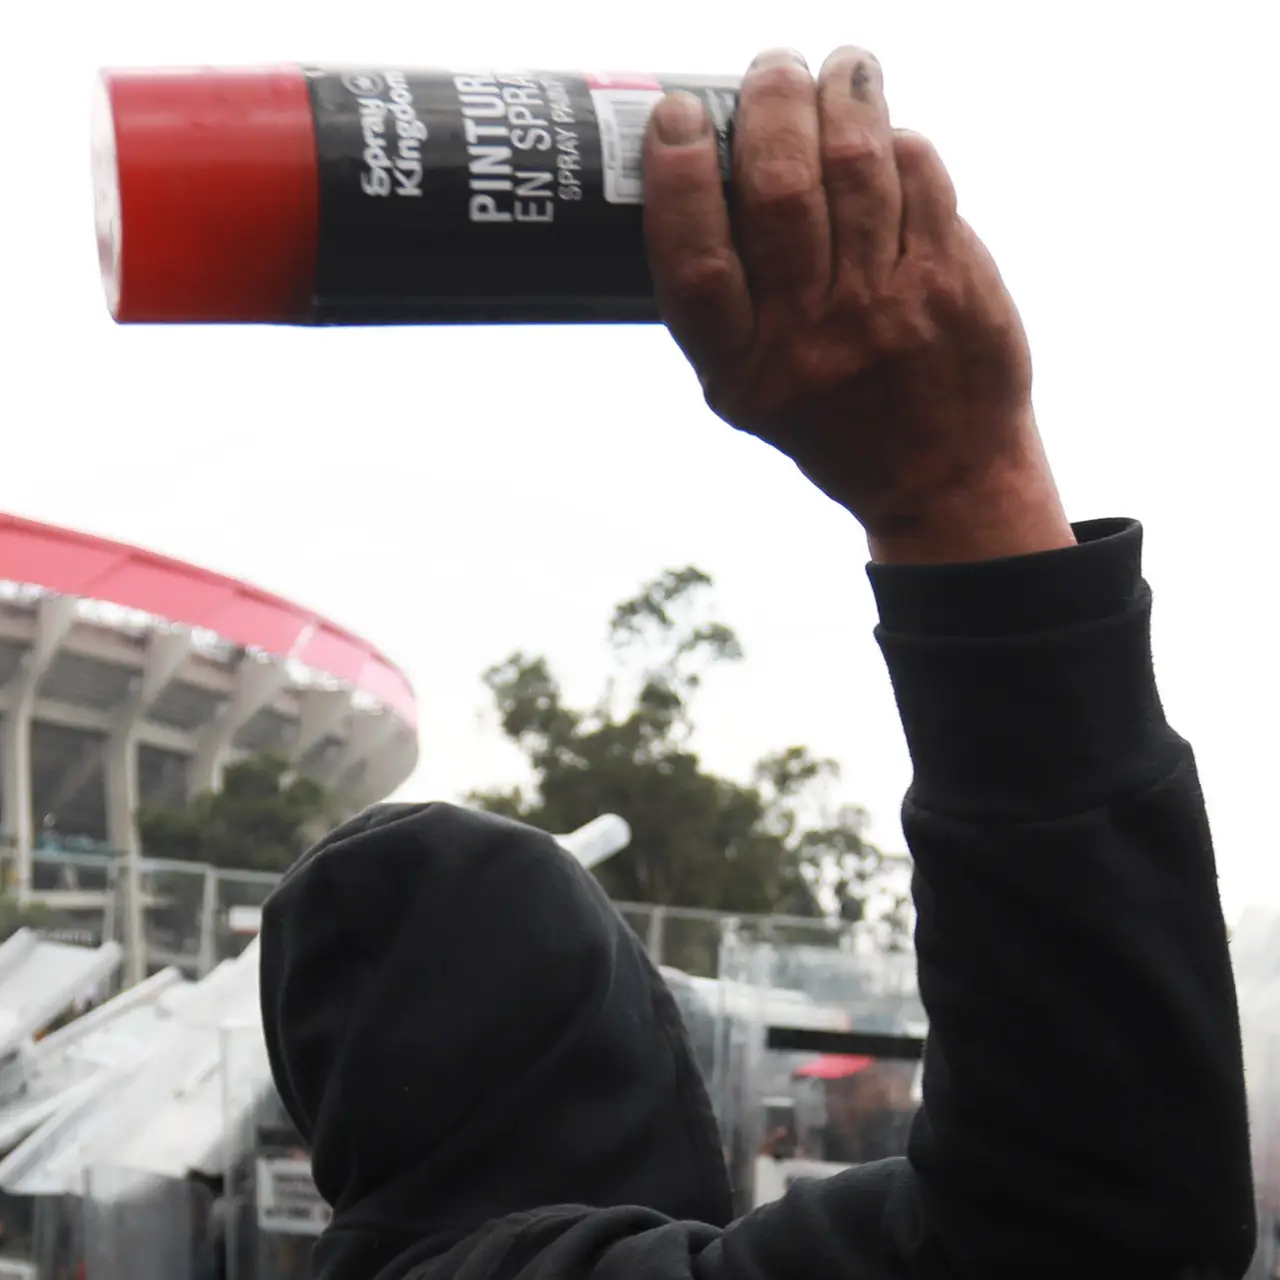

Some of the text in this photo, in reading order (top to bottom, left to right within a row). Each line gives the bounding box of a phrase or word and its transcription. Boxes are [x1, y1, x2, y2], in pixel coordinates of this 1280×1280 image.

[357, 97, 393, 197] Spray
[453, 75, 514, 222] PINTUR
[553, 126, 582, 200] SPRAY
[514, 171, 554, 222] EN
